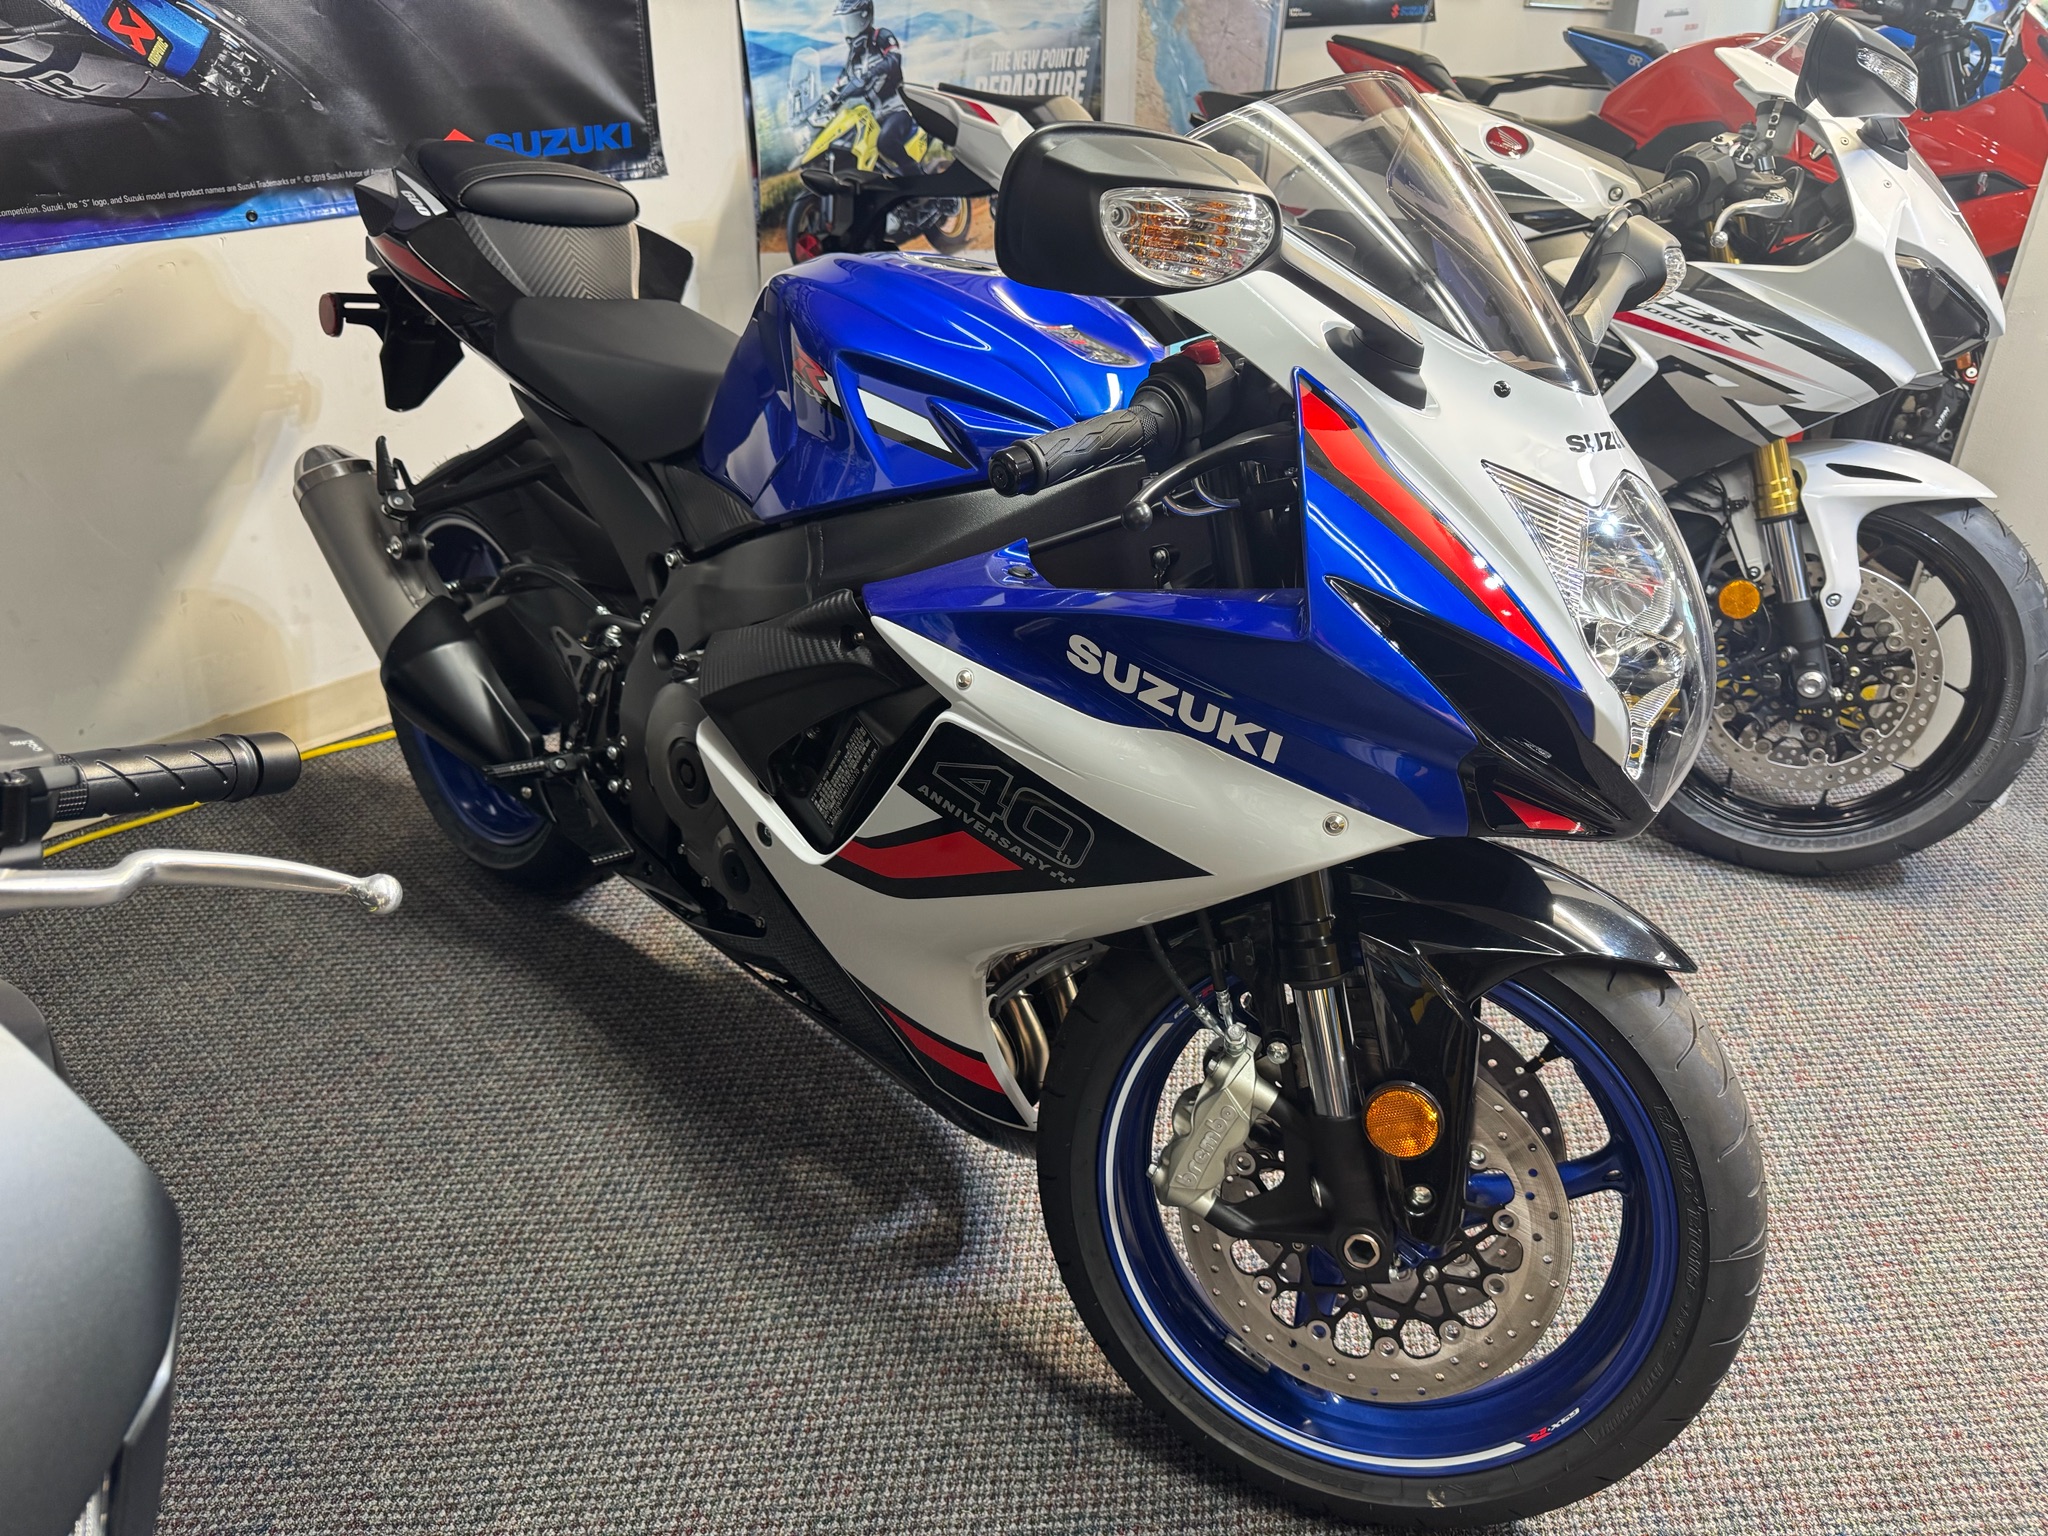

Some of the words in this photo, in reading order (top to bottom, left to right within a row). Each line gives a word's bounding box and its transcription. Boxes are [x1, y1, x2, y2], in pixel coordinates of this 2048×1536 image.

[991, 52, 1012, 72] THE
[1012, 48, 1039, 71] NEW
[1040, 47, 1075, 69] POINT
[1074, 46, 1091, 68] OF
[41, 201, 66, 213] Suzuki,
[66, 201, 78, 210] the
[92, 197, 110, 208] logo,
[110, 196, 124, 205] and
[124, 193, 145, 204] Suzuki
[145, 192, 167, 201] model
[167, 189, 182, 199] and
[181, 187, 205, 199] product
[204, 185, 226, 195] names
[226, 184, 238, 193] are
[237, 180, 257, 192] Suzuki
[256, 177, 289, 189] Trademarks
[289, 177, 297, 185] or
[312, 172, 327, 183] 2019
[326, 170, 345, 181] Suzuki
[345, 168, 363, 179] Motor
[363, 167, 371, 177] of
[401, 190, 431, 217] 600
[1643, 306, 1731, 344] 000RR
[1066, 634, 1284, 764] SUZUKI
[917, 784, 1052, 871] ANNIVERSARY
[932, 761, 1095, 869] 40
[1056, 850, 1073, 866] th
[1176, 1104, 1238, 1188] brembo
